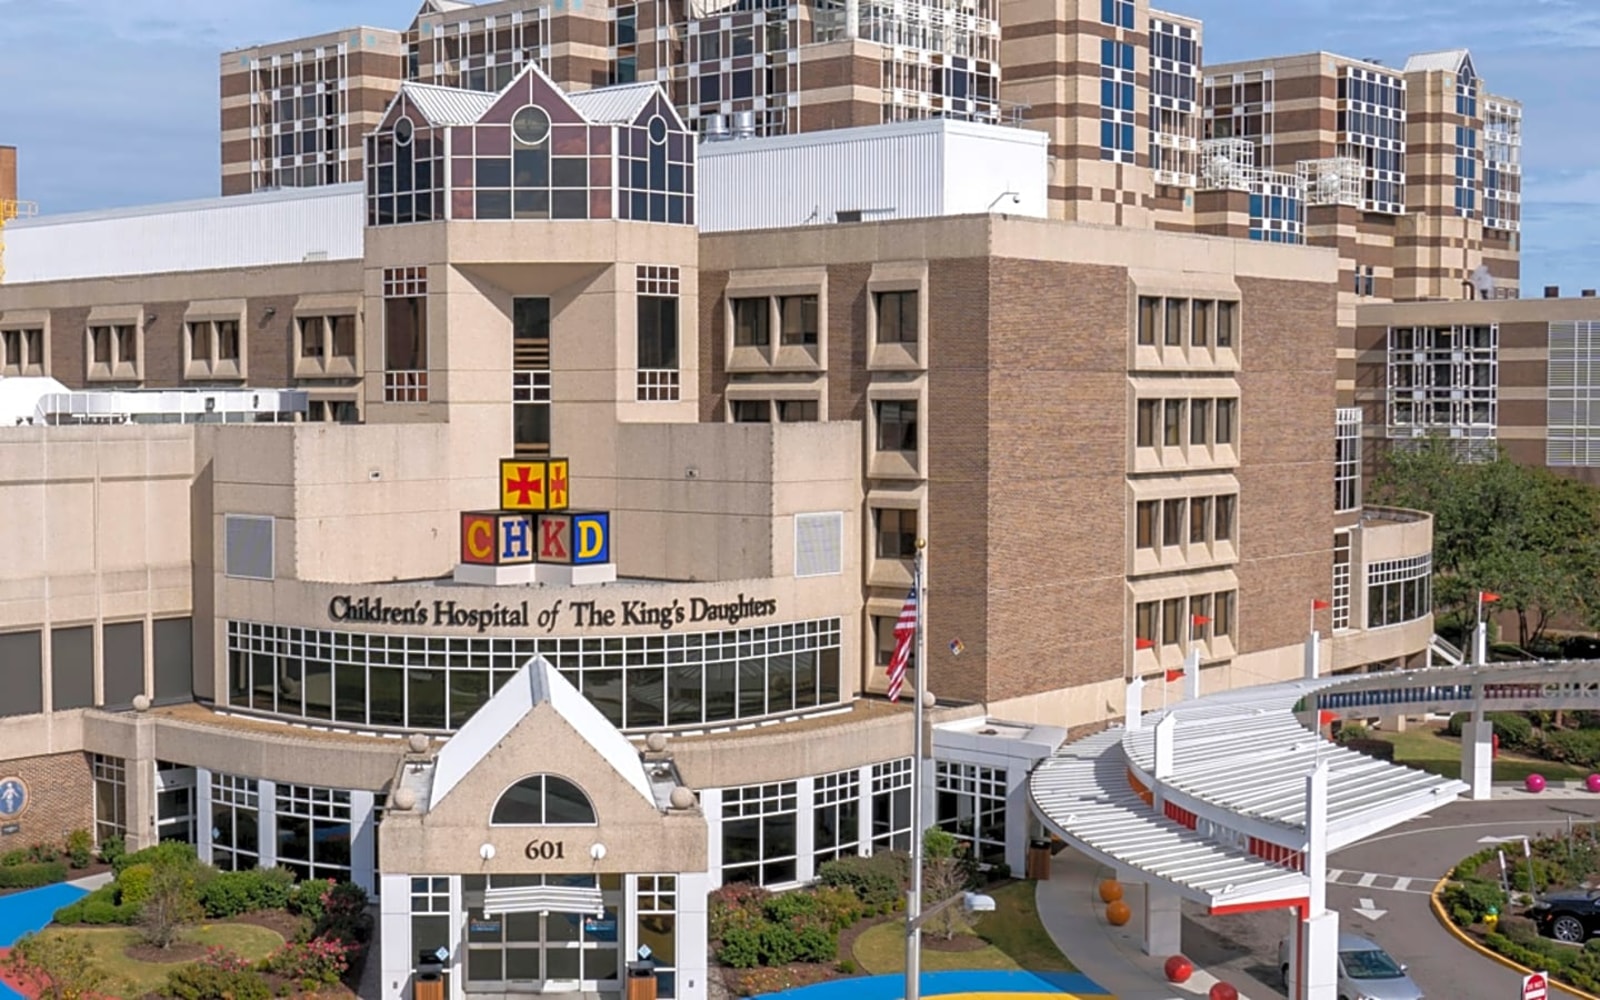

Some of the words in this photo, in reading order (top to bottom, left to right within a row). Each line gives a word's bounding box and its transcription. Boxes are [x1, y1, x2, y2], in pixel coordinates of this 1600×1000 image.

[467, 519, 604, 558] CHKD
[329, 595, 429, 625] Children's
[432, 601, 529, 632] Hospital
[537, 599, 562, 633] of
[569, 600, 615, 627] The
[621, 599, 685, 630] King's
[689, 593, 777, 624] Daughters
[525, 839, 565, 860] 601
